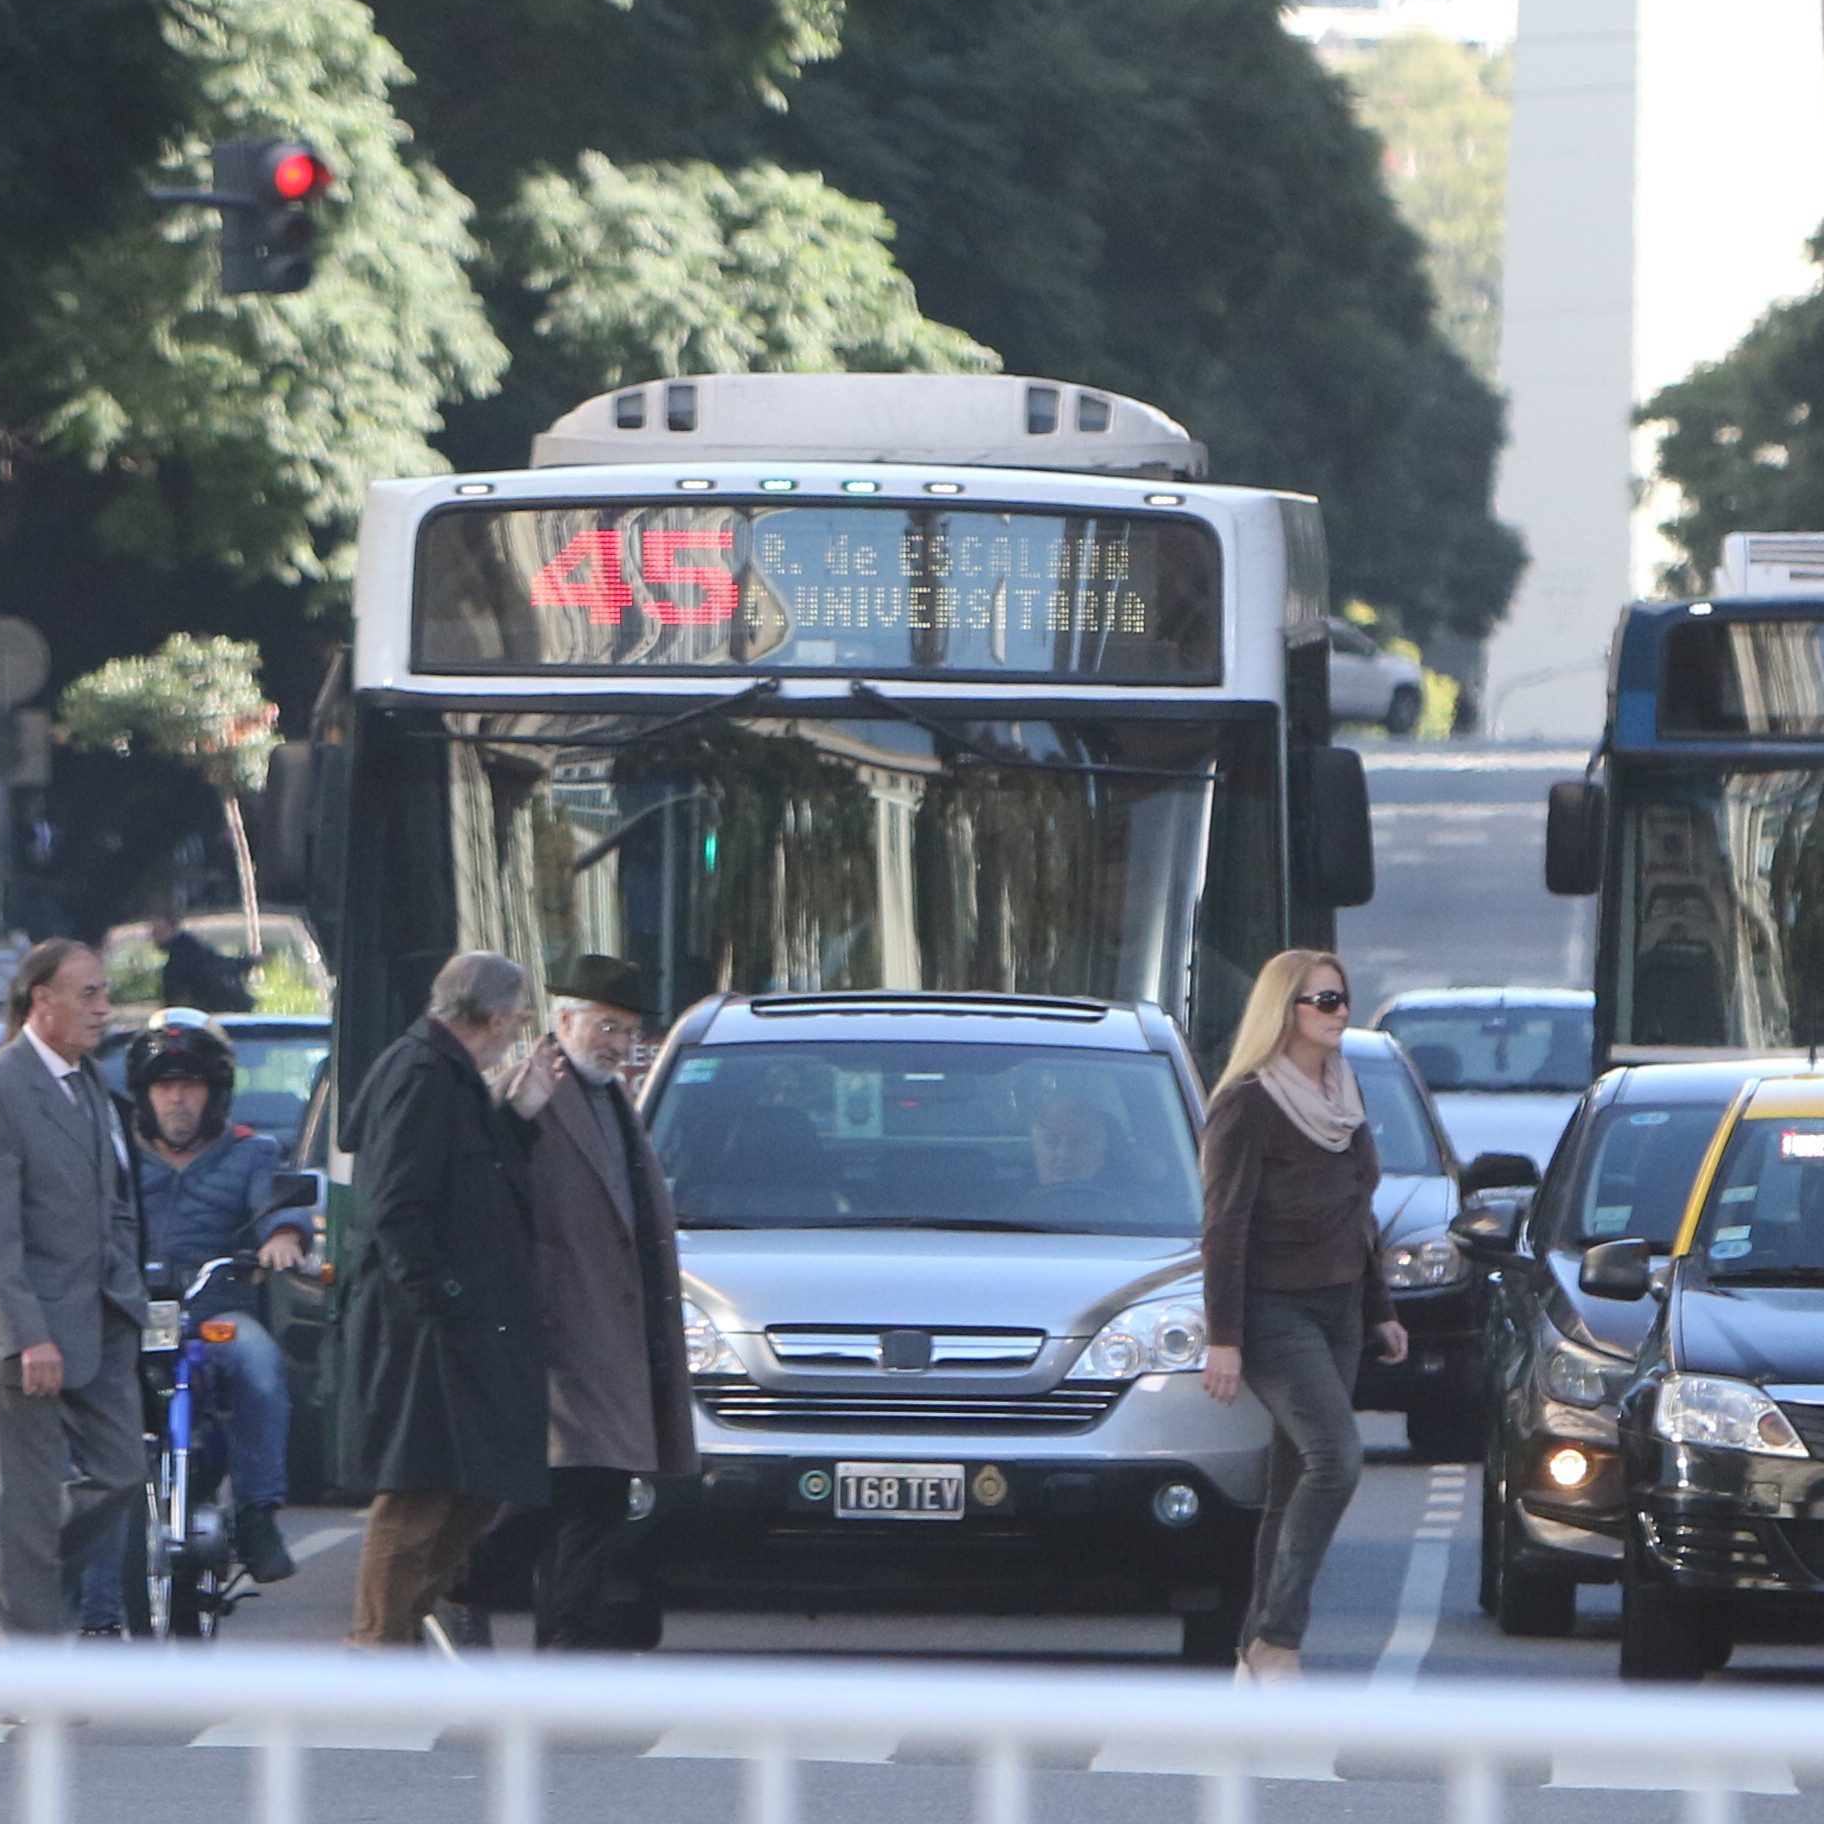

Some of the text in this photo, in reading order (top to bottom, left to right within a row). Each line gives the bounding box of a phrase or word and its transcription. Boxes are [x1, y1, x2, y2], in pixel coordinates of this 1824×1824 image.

[530, 529, 740, 626] 45
[762, 532, 1130, 581] R. de ESCALADA
[843, 1476, 901, 1510] 168
